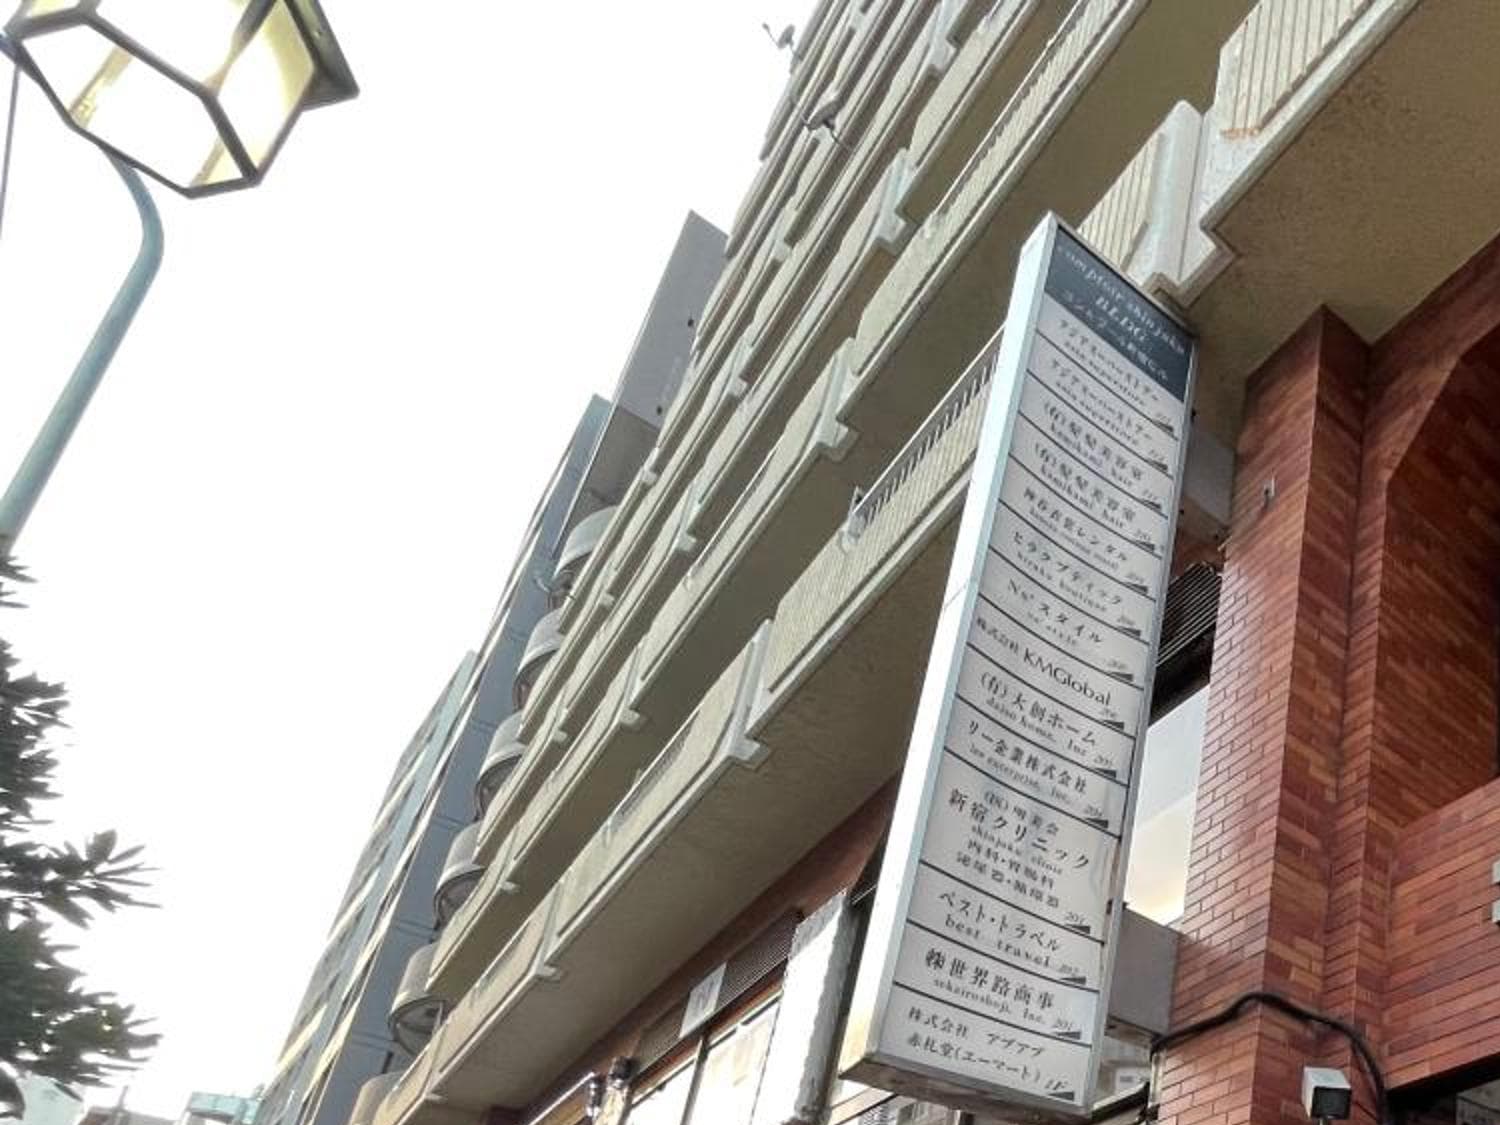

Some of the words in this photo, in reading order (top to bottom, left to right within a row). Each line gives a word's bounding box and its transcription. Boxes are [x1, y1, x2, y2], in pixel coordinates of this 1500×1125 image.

[1023, 647, 1112, 707] KMGlobal
[949, 787, 1090, 870] 新宿クリニック
[938, 890, 1061, 953] ベスト・トラベル
[945, 916, 982, 941] best
[996, 938, 1051, 968] travel
[907, 1005, 969, 1038] 株式会社
